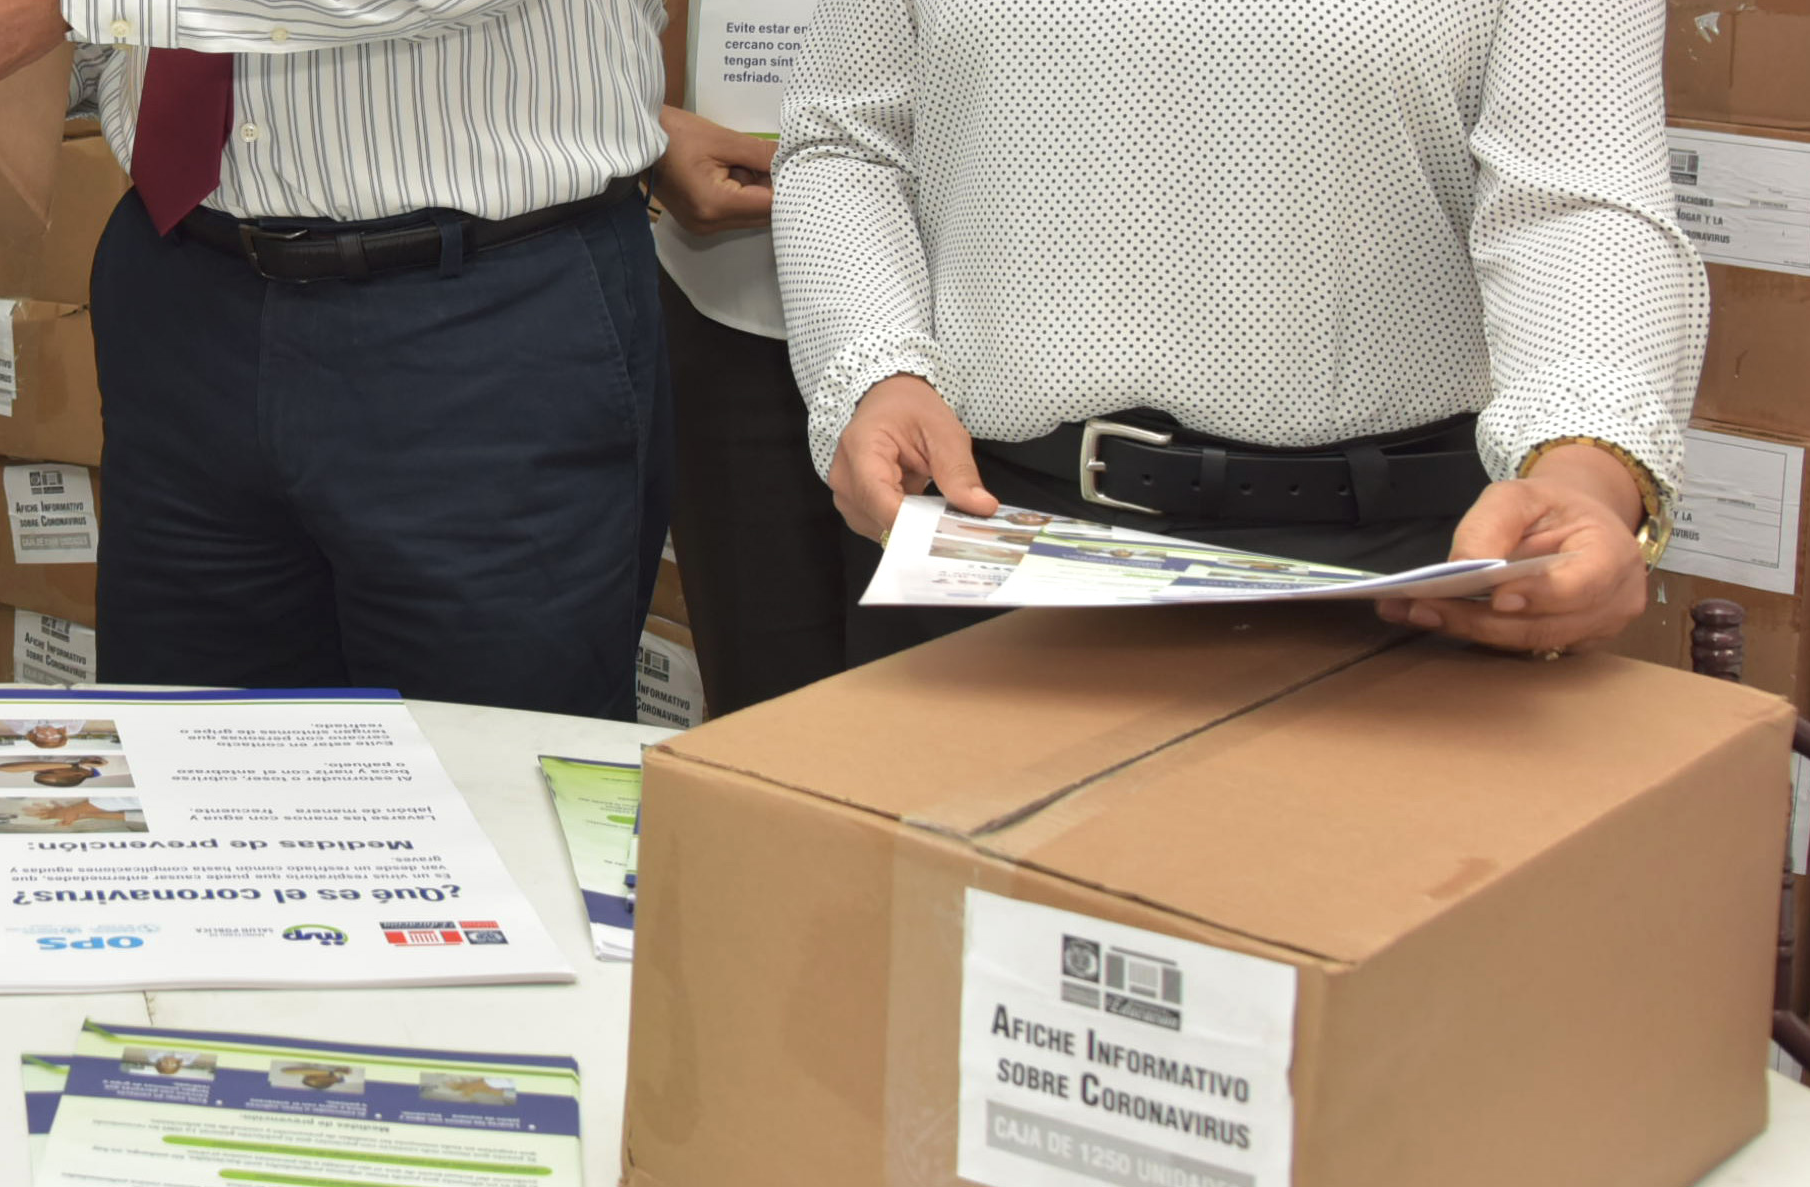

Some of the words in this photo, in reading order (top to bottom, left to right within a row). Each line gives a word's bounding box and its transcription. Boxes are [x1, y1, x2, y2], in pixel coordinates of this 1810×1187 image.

[726, 21, 756, 33] Evite
[758, 23, 790, 34] estar
[725, 41, 774, 50] cercano
[777, 42, 801, 51] con
[724, 55, 767, 69] tengan
[723, 71, 783, 83] resfriado.
[1675, 194, 1714, 207] TACIONES
[1705, 216, 1711, 225] Y
[1713, 216, 1724, 226] LA
[1683, 230, 1731, 244] RONAVIRUS
[1671, 528, 1700, 541] AVIRUS
[637, 680, 690, 711] INFORMATIVO
[27, 838, 218, 852] prevención:
[229, 840, 268, 851] de
[278, 840, 414, 851] Medidas
[390, 855, 442, 863] graves.
[22, 866, 73, 875] agudas
[78, 865, 188, 875] complicaciones
[287, 865, 350, 873] resfriado
[11, 874, 38, 882] que
[206, 872, 250, 881] puede
[254, 872, 281, 880] que
[286, 872, 368, 881] respiratorio
[373, 873, 408, 881] virus
[12, 888, 262, 905] coronavirus?
[273, 888, 307, 904] el
[317, 888, 361, 901] es
[371, 884, 460, 904] ¿Qué
[36, 936, 144, 950] OPS
[991, 1003, 1076, 1057] AFICHE
[1087, 1029, 1250, 1104] INFORMATIVO
[997, 1058, 1070, 1099] SOBRE
[1080, 1072, 1251, 1150] CORONAVIRUS
[994, 1115, 1041, 1149] CAJA
[1047, 1131, 1073, 1159] DE
[1080, 1142, 1132, 1175] 1250
